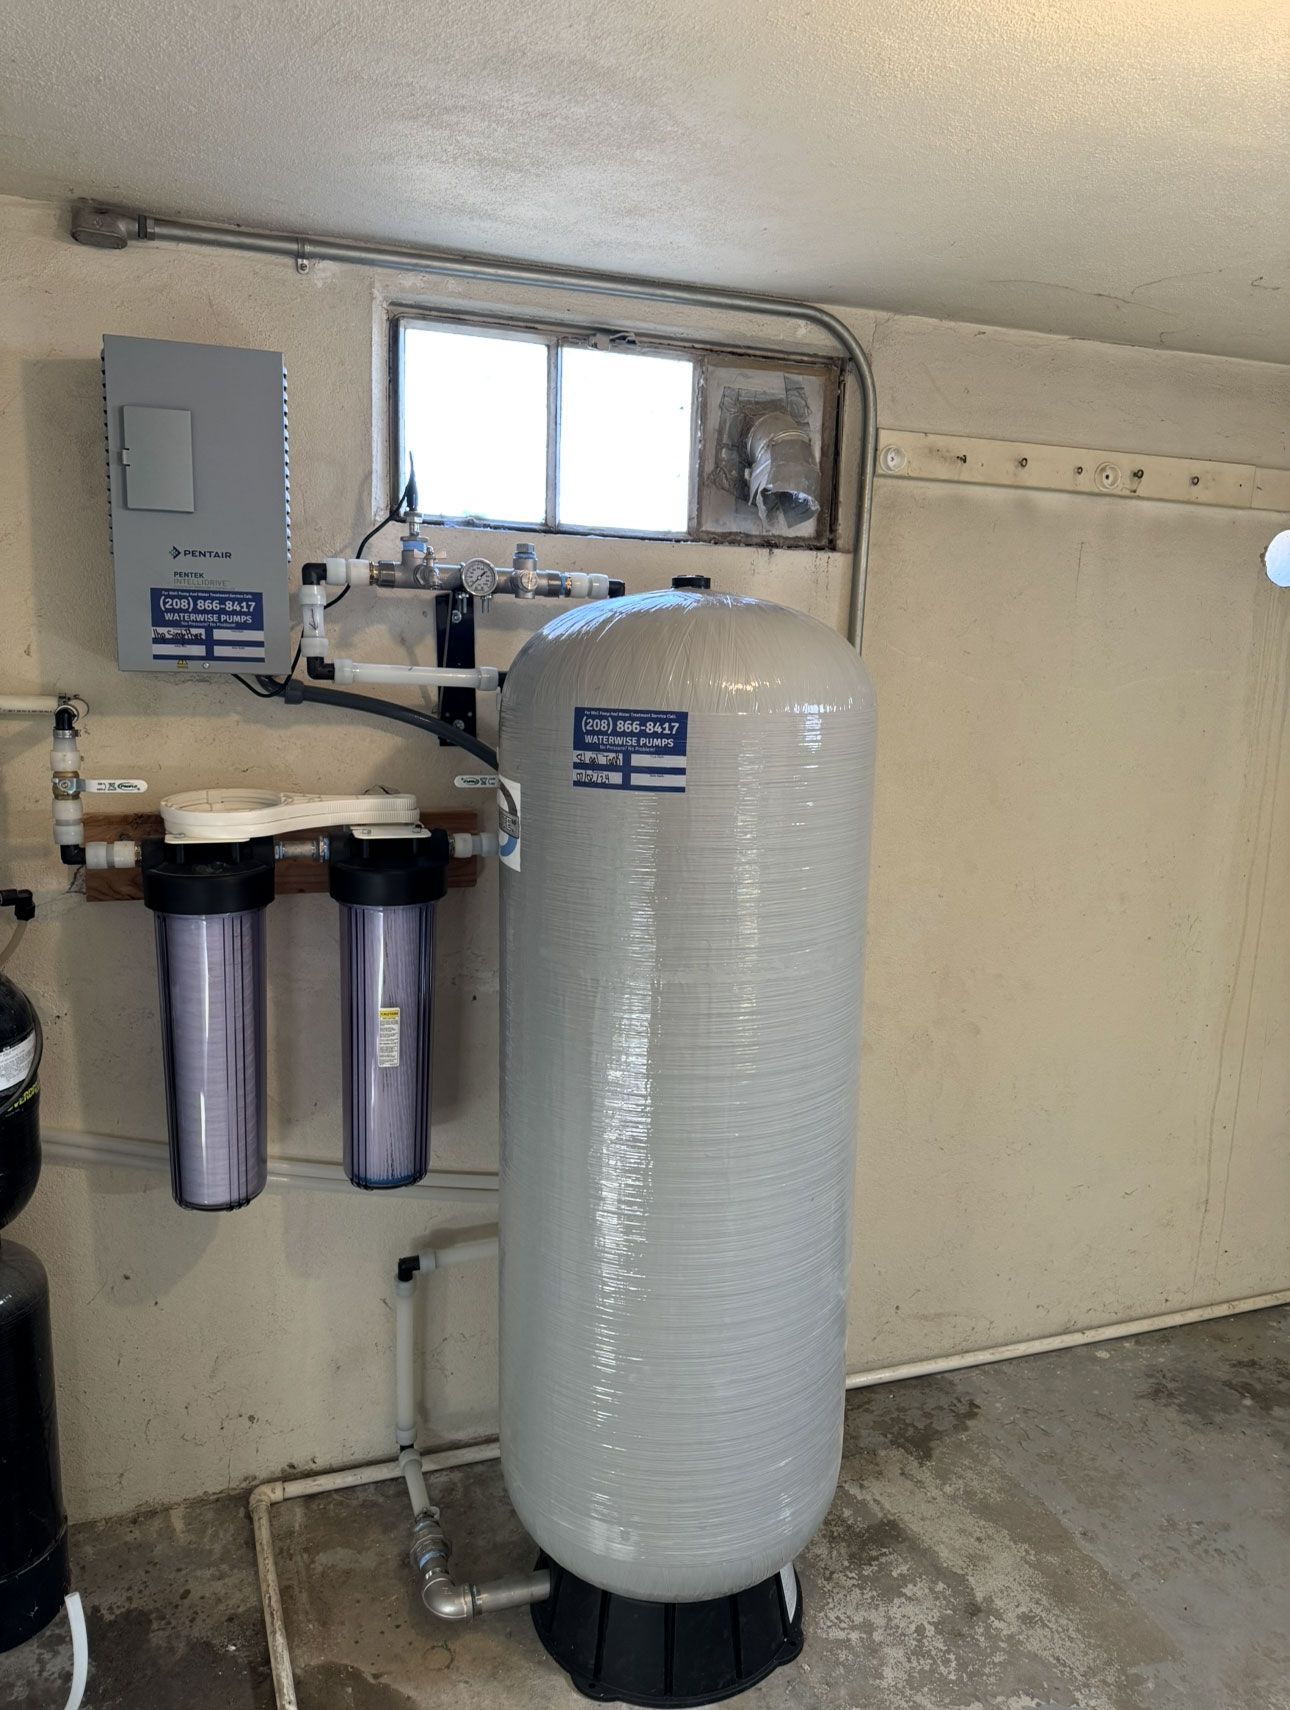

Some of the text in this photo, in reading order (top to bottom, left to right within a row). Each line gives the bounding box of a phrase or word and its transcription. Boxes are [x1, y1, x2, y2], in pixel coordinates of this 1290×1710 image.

[183, 549, 232, 560] PENTAIR
[173, 571, 205, 579] PENTEK
[160, 595, 256, 612] (208) 866-8417
[164, 612, 253, 624] WATERWISE PUMPS
[581, 716, 679, 735] (208) 866-8417
[584, 734, 674, 747] WATERWISE PUMPS
